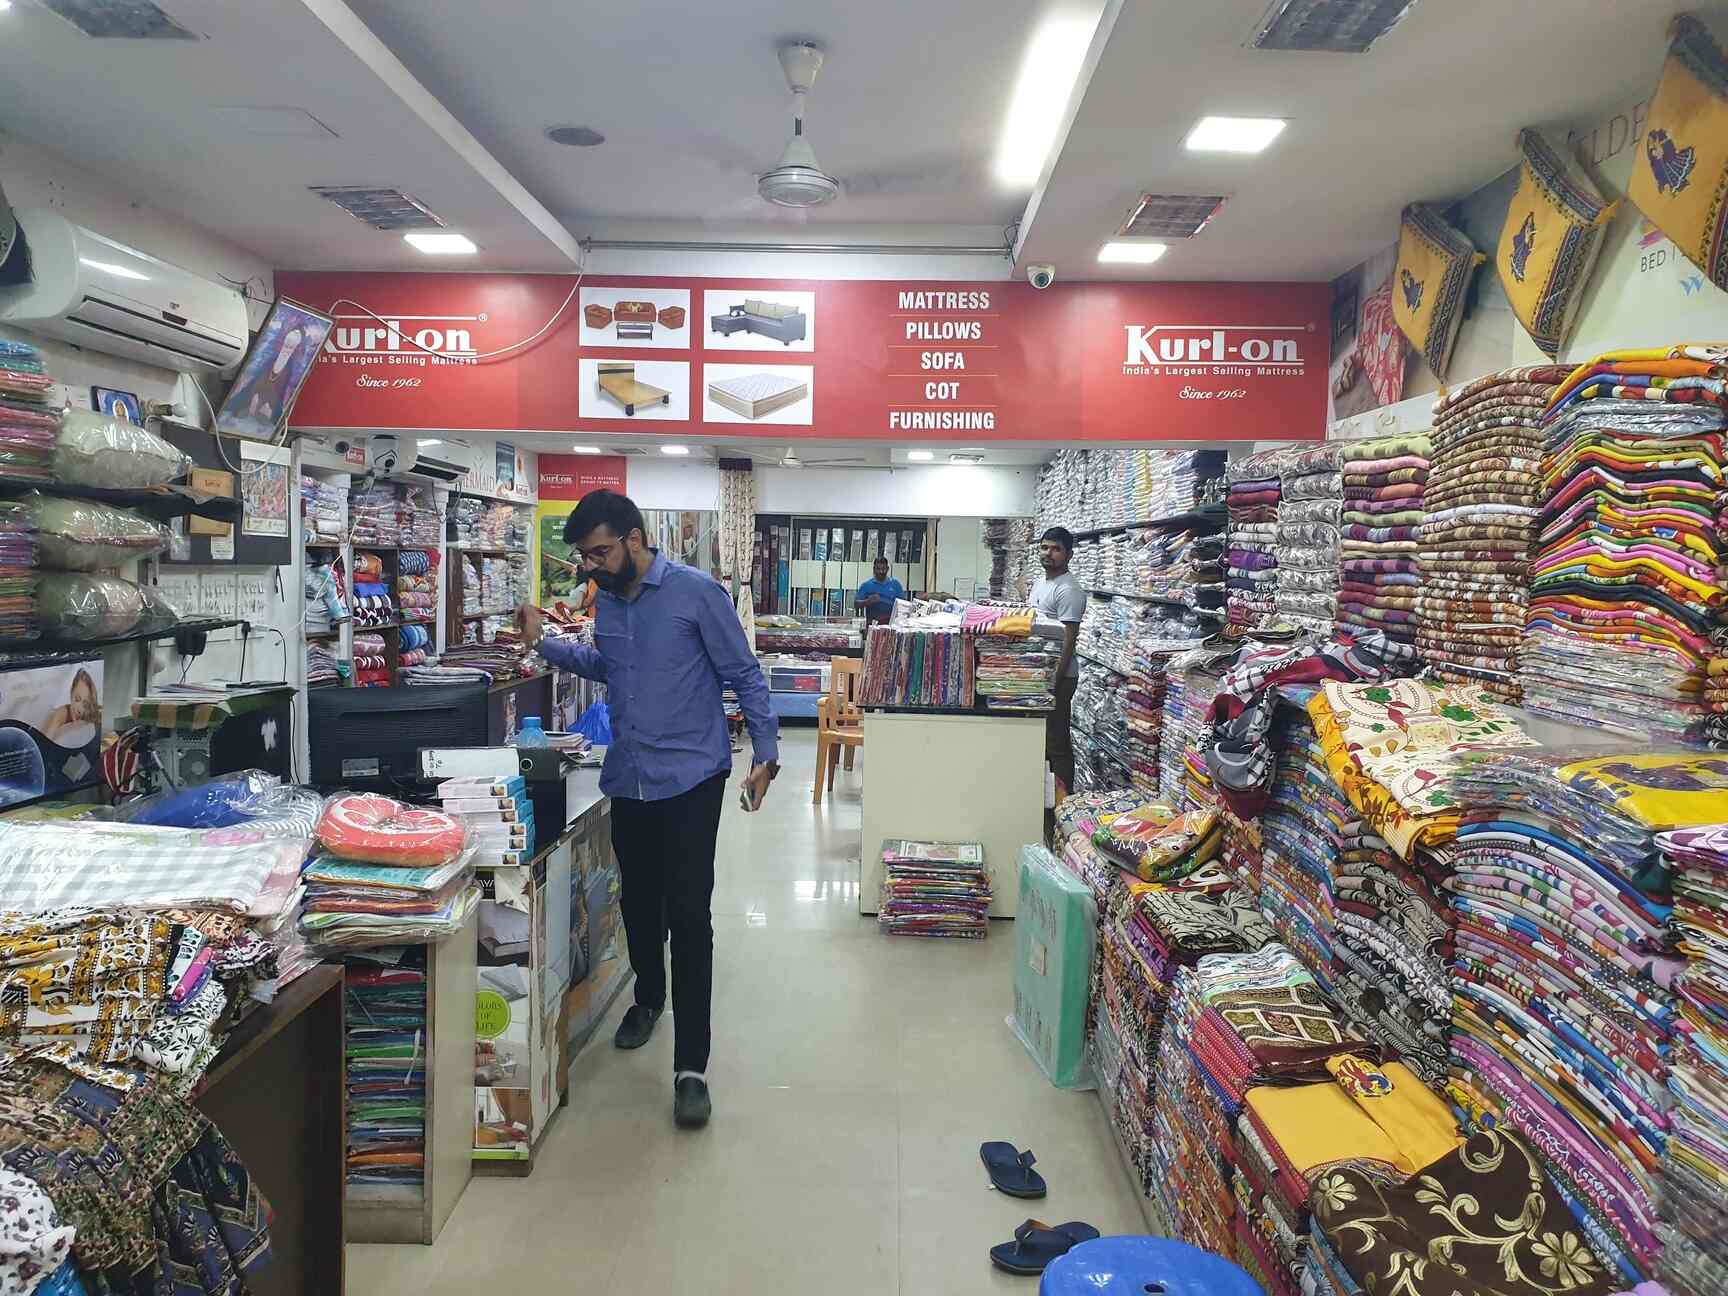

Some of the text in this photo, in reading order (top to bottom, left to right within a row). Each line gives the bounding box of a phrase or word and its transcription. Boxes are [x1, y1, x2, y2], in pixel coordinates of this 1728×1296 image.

[1640, 249, 1667, 273] BED
[898, 291, 990, 310] MATTRESS
[906, 321, 982, 340] PILLOWS
[1124, 325, 1305, 365] Kurl-on
[343, 356, 383, 366] Largest
[388, 356, 426, 367] Selling
[921, 351, 965, 370] SOFA
[356, 374, 422, 388] Since 1962
[1123, 366, 1305, 378] India's Largest Selling Mattress
[925, 381, 960, 400] COT
[1179, 385, 1248, 400] Since 1962
[889, 411, 995, 430] FURNISHING
